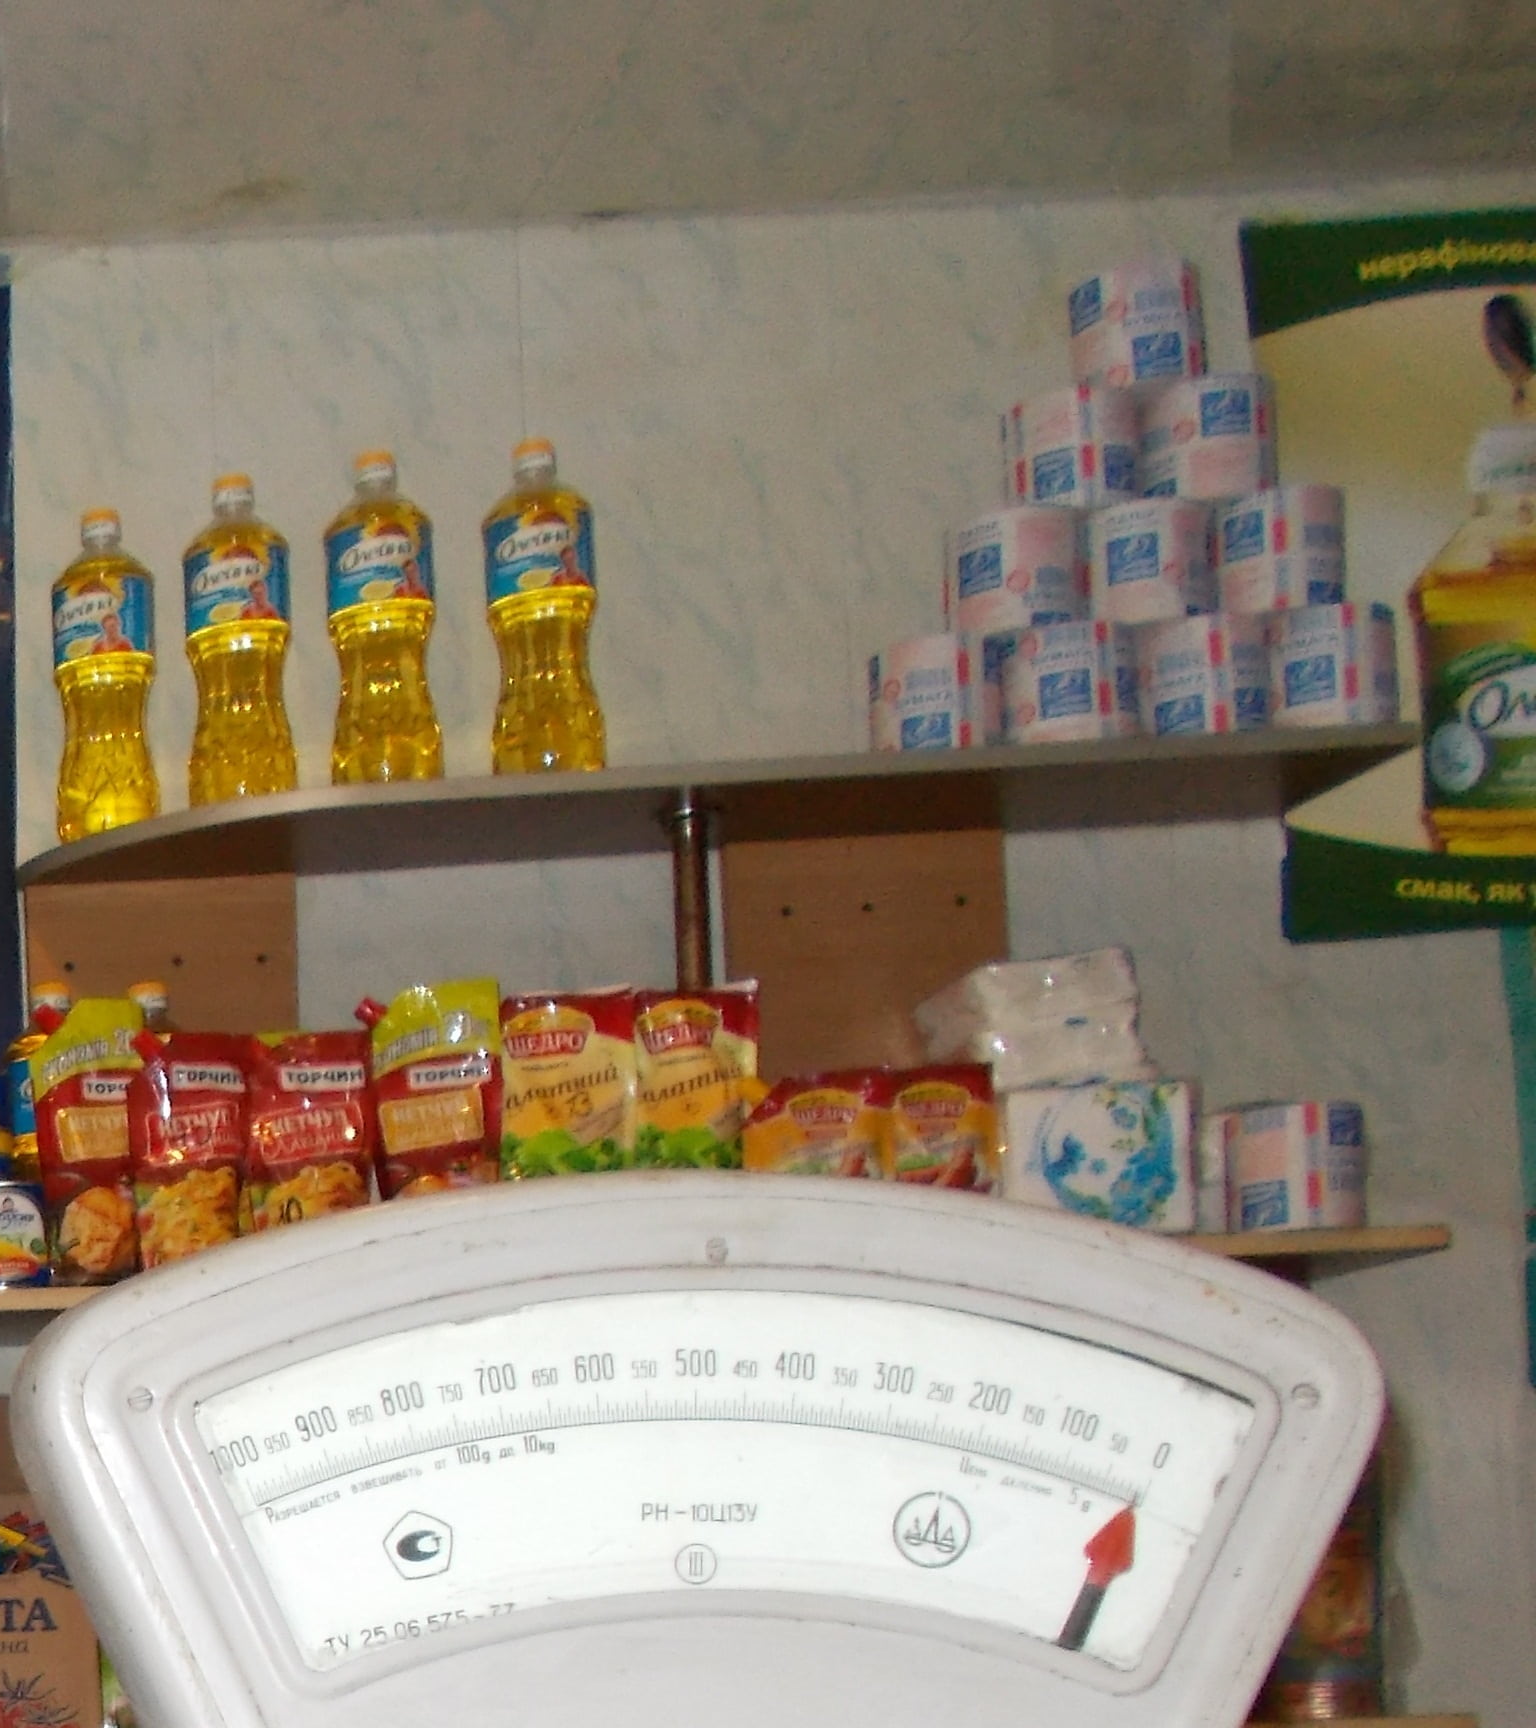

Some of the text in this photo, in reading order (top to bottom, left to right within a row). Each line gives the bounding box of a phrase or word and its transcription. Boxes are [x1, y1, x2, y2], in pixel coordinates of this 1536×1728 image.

[506, 1033, 583, 1052] ЩЕДРО
[86, 1082, 128, 1094] ТОРЧ
[285, 1068, 363, 1085] ТОРЧИН
[573, 1352, 615, 1384] 600
[631, 1359, 658, 1379] 550
[674, 1348, 717, 1378] 500
[732, 1360, 759, 1379] 450
[774, 1351, 816, 1381] 400
[473, 1362, 517, 1396] 700
[531, 1366, 559, 1388] 650
[832, 1366, 858, 1388] 350
[873, 1360, 915, 1395] 300
[379, 1380, 425, 1417] 800
[436, 1382, 464, 1405] 750
[927, 1381, 955, 1404] 250
[967, 1380, 1013, 1416] 200
[294, 1405, 338, 1442] 900
[346, 1404, 375, 1427] 850
[1021, 1403, 1046, 1427] 150
[1059, 1405, 1100, 1443] 100
[208, 1434, 260, 1475] 1000
[263, 1430, 291, 1455] 950
[522, 1434, 556, 1455] 10kg
[1110, 1432, 1129, 1455] 50
[1152, 1441, 1172, 1470] 0
